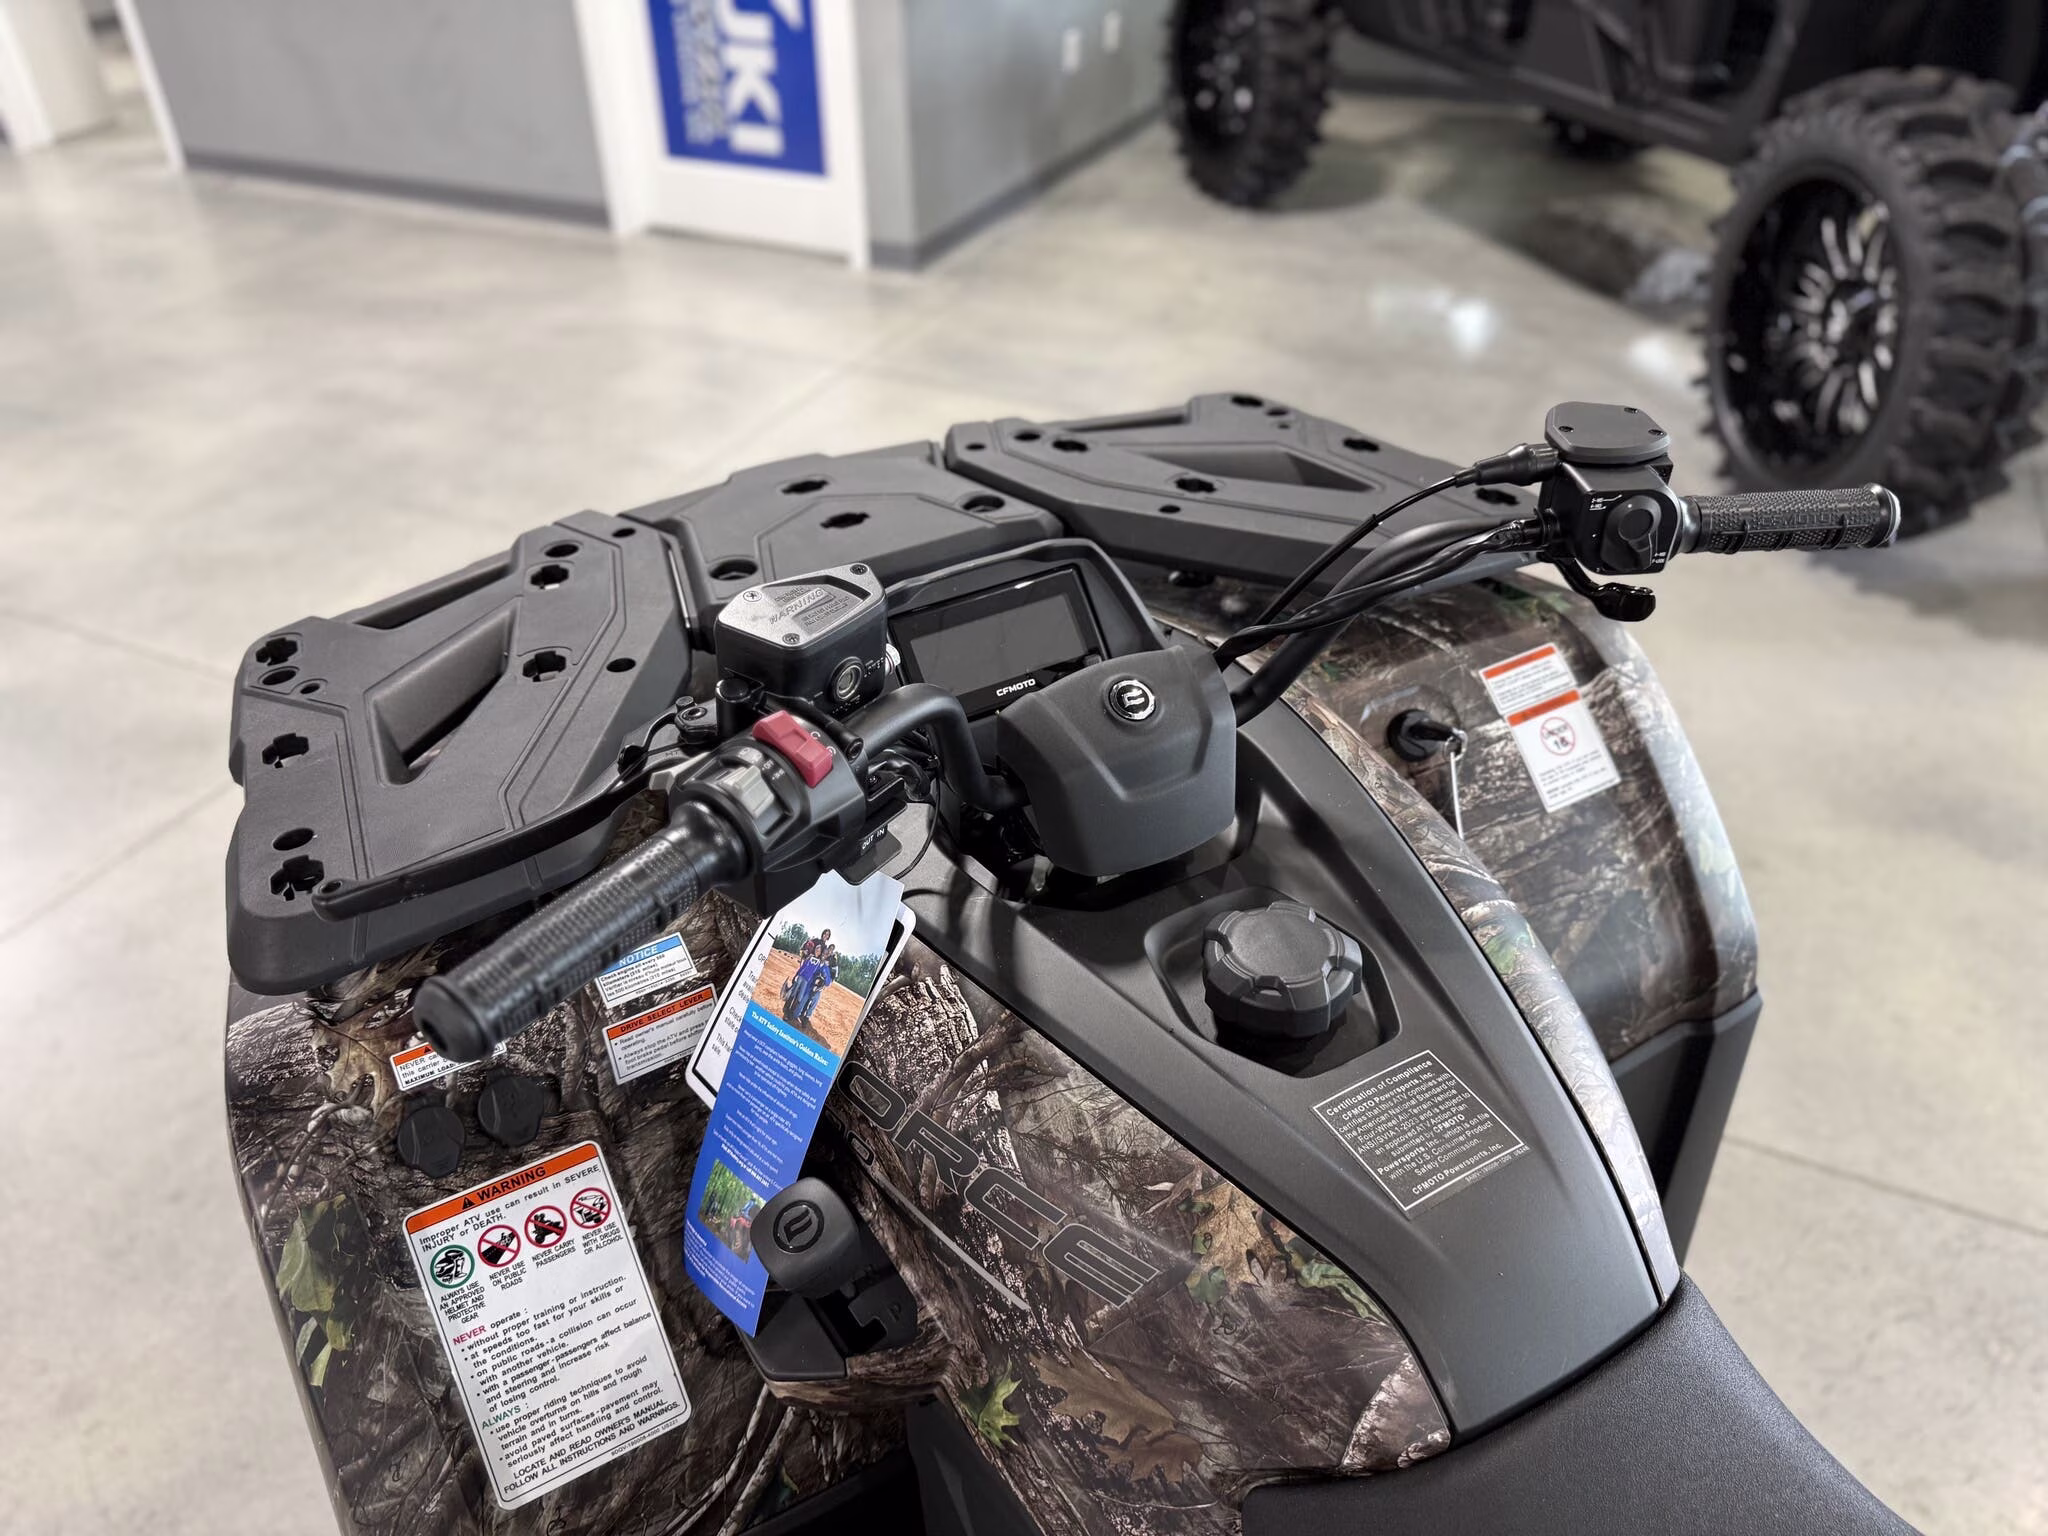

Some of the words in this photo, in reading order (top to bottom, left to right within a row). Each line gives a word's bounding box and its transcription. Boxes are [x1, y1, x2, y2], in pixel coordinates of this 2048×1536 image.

[768, 588, 824, 625] WARNING
[996, 678, 1036, 697] CFMOTO
[862, 834, 874, 850] OUT
[876, 828, 885, 838] IN
[619, 945, 658, 967] NOTICE
[620, 1018, 643, 1032] DRIVE
[646, 1004, 675, 1021] SELECT
[679, 993, 703, 1007] LEVER
[399, 1057, 425, 1071] NEVER
[401, 1070, 414, 1078] this
[417, 1060, 439, 1072] carrier
[404, 1070, 434, 1084] MAXIMUM
[1326, 1087, 1377, 1115] Certification
[1377, 1081, 1386, 1089] of
[1385, 1060, 1432, 1084] Compliance
[1341, 1100, 1374, 1120] CFMOTO
[476, 1166, 545, 1200] WARNING
[836, 1060, 1161, 1309] ORCE
[1412, 1172, 1444, 1194] CFMOTO
[418, 1223, 458, 1245] Improper
[463, 1213, 479, 1226] ATV
[484, 1207, 500, 1217] use
[504, 1199, 520, 1208] can
[524, 1186, 549, 1200] result
[582, 1227, 602, 1240] NEVER
[603, 1221, 616, 1231] USE
[582, 1237, 597, 1248] WITH
[599, 1227, 620, 1240] DRUGS
[421, 1232, 454, 1252] INJURY
[531, 1248, 552, 1261] NEVER
[554, 1238, 574, 1251] CARRY
[595, 1234, 623, 1250] ALCOHOL
[535, 1245, 576, 1268] PASSENGERS
[488, 1266, 510, 1280] NEVER
[511, 1260, 525, 1270] USE
[503, 1267, 526, 1281] PUBLIC
[440, 1287, 465, 1302] ALWAYS
[466, 1280, 479, 1290] USE
[500, 1276, 522, 1290] ROADS
[444, 1300, 468, 1315] HELMET
[471, 1294, 484, 1304] AND
[451, 1286, 484, 1305] APPROVED
[447, 1300, 485, 1322] PROTECTIVE
[461, 1311, 478, 1323] GEAR
[482, 1336, 512, 1353] speeds
[533, 1318, 549, 1330] fast
[567, 1302, 586, 1316] your
[590, 1291, 611, 1304] skills
[452, 1325, 486, 1345] NEVER
[490, 1311, 520, 1328] operate
[466, 1331, 499, 1350] without
[502, 1317, 529, 1335] proper
[533, 1302, 565, 1320] training
[491, 1354, 517, 1371] public
[558, 1319, 593, 1338] collision
[614, 1298, 636, 1313] occur
[482, 1383, 499, 1394] with
[600, 1325, 621, 1339] affect
[623, 1312, 651, 1328] balance
[479, 1374, 497, 1385] with
[501, 1357, 532, 1376] another
[504, 1375, 537, 1394] steering
[558, 1350, 591, 1369] increase
[594, 1341, 609, 1352] risk
[500, 1391, 526, 1407] losing
[513, 1407, 539, 1425] proper
[543, 1395, 567, 1410] riding
[569, 1373, 612, 1397] techniques
[626, 1354, 647, 1369] avoid
[497, 1424, 526, 1441] vehicle
[529, 1404, 567, 1426] overturns
[582, 1388, 599, 1400] hills
[620, 1367, 642, 1382] rough
[481, 1405, 520, 1429] ALWAYS
[500, 1434, 527, 1450] terrain
[504, 1443, 527, 1459] avoid
[531, 1429, 556, 1447] paved
[507, 1444, 545, 1467] seriously
[549, 1431, 573, 1446] affect
[575, 1412, 611, 1433] handling
[513, 1457, 546, 1479] LOCATE
[549, 1448, 566, 1461] AND
[568, 1435, 591, 1451] READ
[594, 1415, 630, 1438] OWNER'S
[503, 1471, 538, 1493] FOLLOW
[541, 1463, 557, 1475] ALL
[559, 1432, 616, 1465] INSTRUCTIONS
[618, 1422, 635, 1436] AND
